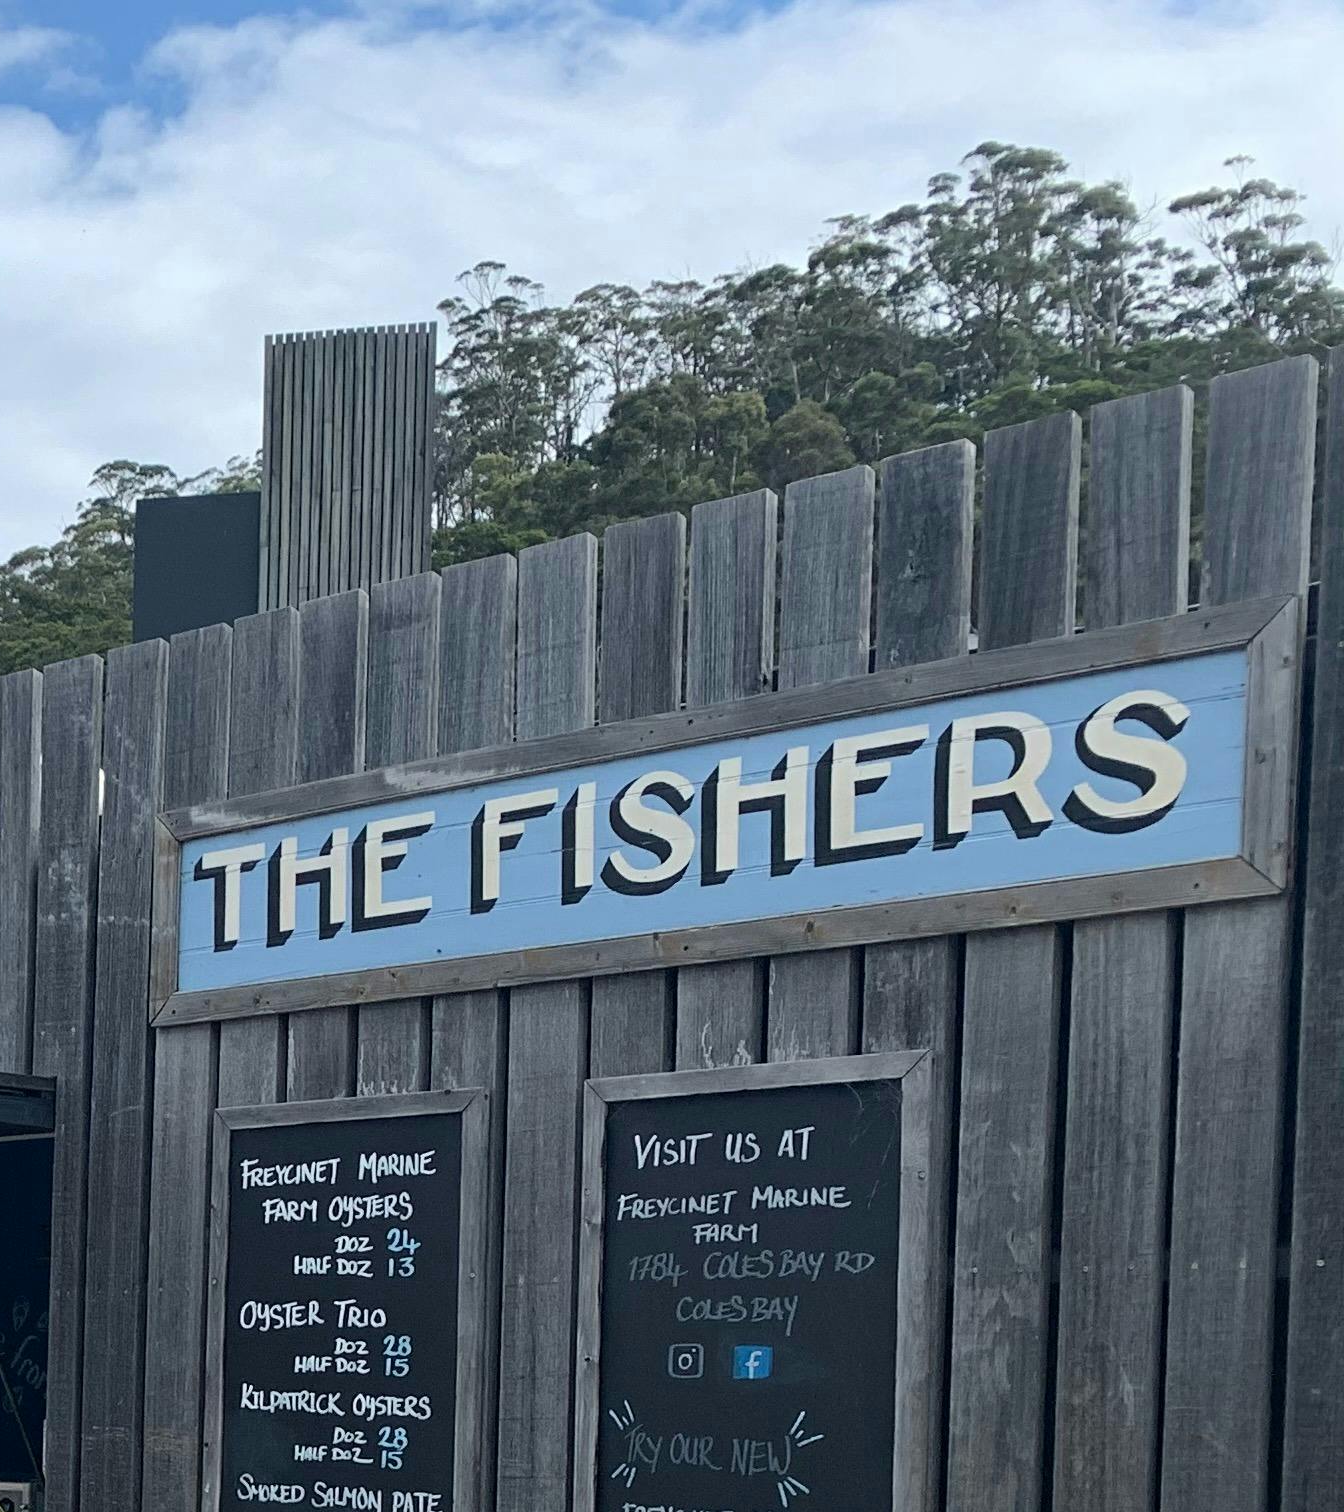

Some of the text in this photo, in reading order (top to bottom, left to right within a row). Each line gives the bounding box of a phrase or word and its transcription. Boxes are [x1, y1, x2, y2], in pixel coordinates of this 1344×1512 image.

[193, 688, 1190, 953] THE FISHERS
[633, 1125, 815, 1170] VISIT US AT
[240, 1150, 437, 1190] FREYCINET MARINE
[262, 1191, 414, 1227] FARM OYSTERS
[616, 1184, 852, 1221] FREYCINET MARINE
[334, 1228, 421, 1254] DOZ 24
[692, 1222, 759, 1244] FARM
[293, 1255, 415, 1278] HALF DOZ 13
[628, 1251, 688, 1288] 1784
[834, 1250, 875, 1275] RD
[239, 1299, 387, 1331] OYSTER TRIO
[334, 1335, 412, 1357] DOZ 28
[294, 1356, 410, 1377] HALF DOZ 15
[240, 1382, 432, 1421] KILPATRICK OYSTERS
[333, 1426, 408, 1451] DOZ 28
[624, 1424, 792, 1476] TRY OUR NEW
[294, 1445, 404, 1470] HALF DOZ 15
[237, 1473, 306, 1504] SMOKED
